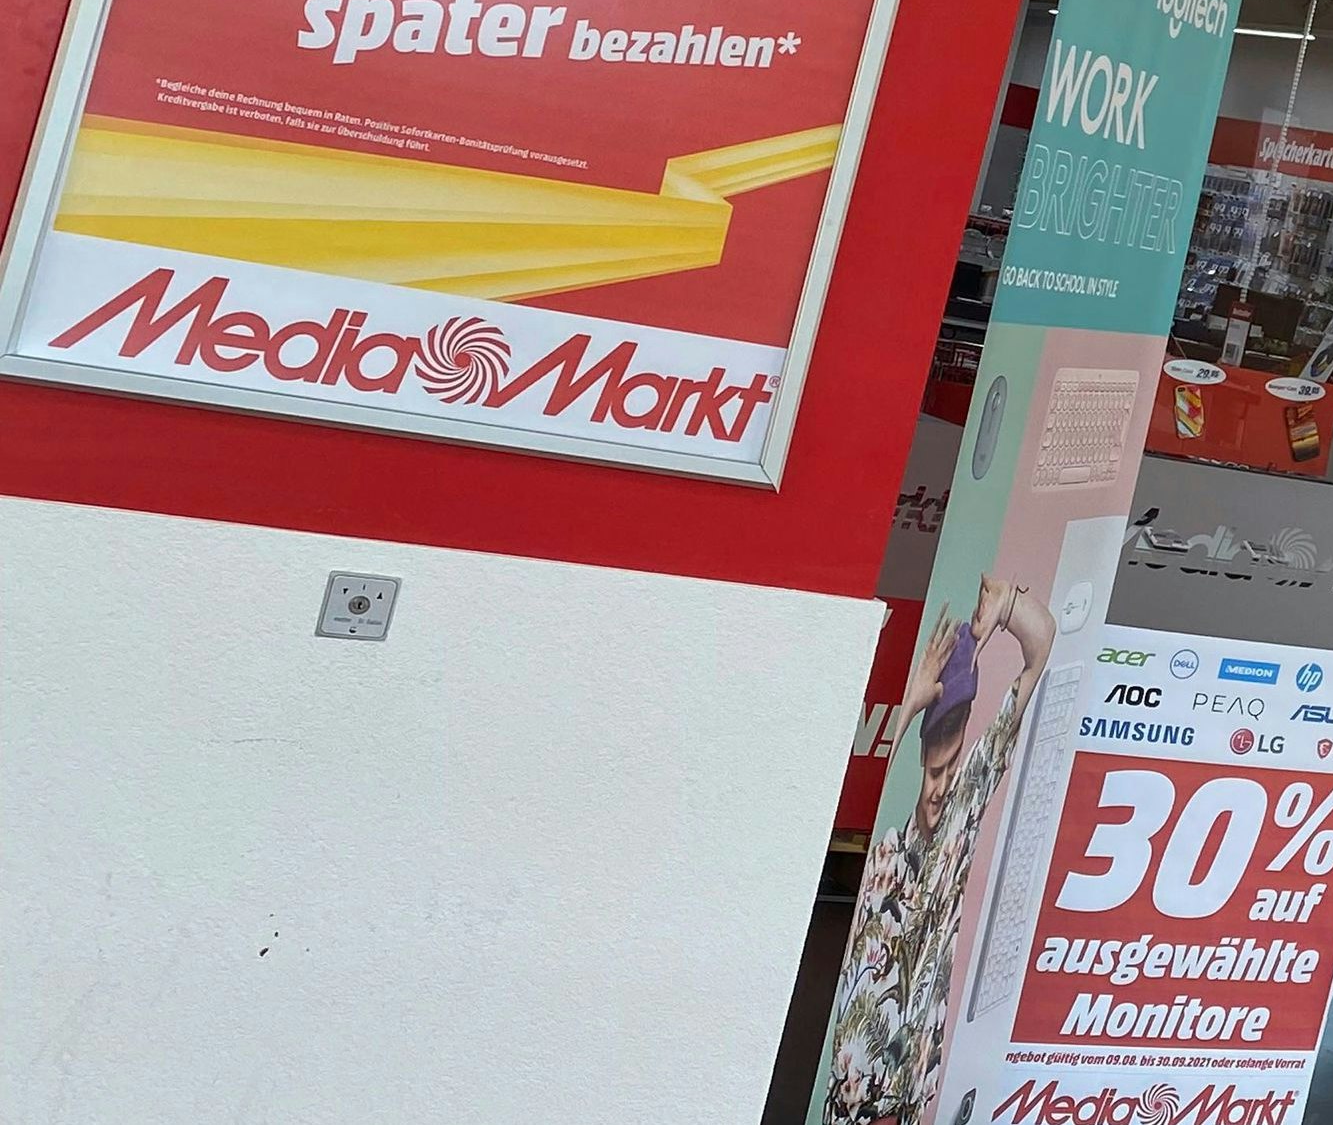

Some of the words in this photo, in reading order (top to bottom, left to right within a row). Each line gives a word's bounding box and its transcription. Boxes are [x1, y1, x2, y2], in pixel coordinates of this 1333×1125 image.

[208, 89, 235, 102] deine
[236, 93, 283, 111] Rechnung
[285, 103, 322, 118] bequem
[323, 110, 333, 120] in
[335, 112, 362, 126] Raten.
[365, 118, 399, 133] Positive
[1046, 39, 1159, 150] WORK
[158, 93, 224, 113] Kreditvergabe
[226, 105, 238, 115] ist
[240, 109, 283, 125] verboten,
[285, 116, 305, 128] falls
[307, 120, 320, 129] sie
[322, 123, 336, 134] zur
[338, 125, 404, 147] Überschuldung
[406, 139, 430, 152] führt.
[1017, 144, 1183, 254] BRIGHTER
[1003, 266, 1016, 285] GO
[1016, 267, 1043, 288] BACK
[1042, 271, 1054, 290] TO
[1054, 272, 1086, 294] SCHOOL
[1086, 277, 1098, 295] IN
[1096, 279, 1119, 297] STYLE
[48, 267, 420, 394] Media
[487, 333, 772, 443] Markt
[1097, 648, 1156, 668] acer
[1174, 659, 1196, 670] DELL
[1226, 664, 1274, 679] MEDION
[1298, 666, 1322, 692] hp
[1105, 684, 1162, 708] AOC
[1193, 692, 1265, 721] PEAQ
[1080, 717, 1195, 746] SAMSUNG
[1257, 734, 1285, 754] LG
[1249, 884, 1328, 923] auf
[1036, 934, 1319, 985] ausgewählte
[1060, 993, 1270, 1042] Monitore
[1046, 1051, 1080, 1065] gültig
[1081, 1055, 1104, 1064] vom
[1140, 1055, 1155, 1066] bis
[1156, 1056, 1210, 1068] 30.09.2021
[1211, 1057, 1234, 1068] oder
[1235, 1058, 1274, 1070] solange
[1274, 1058, 1305, 1069] Vorrat
